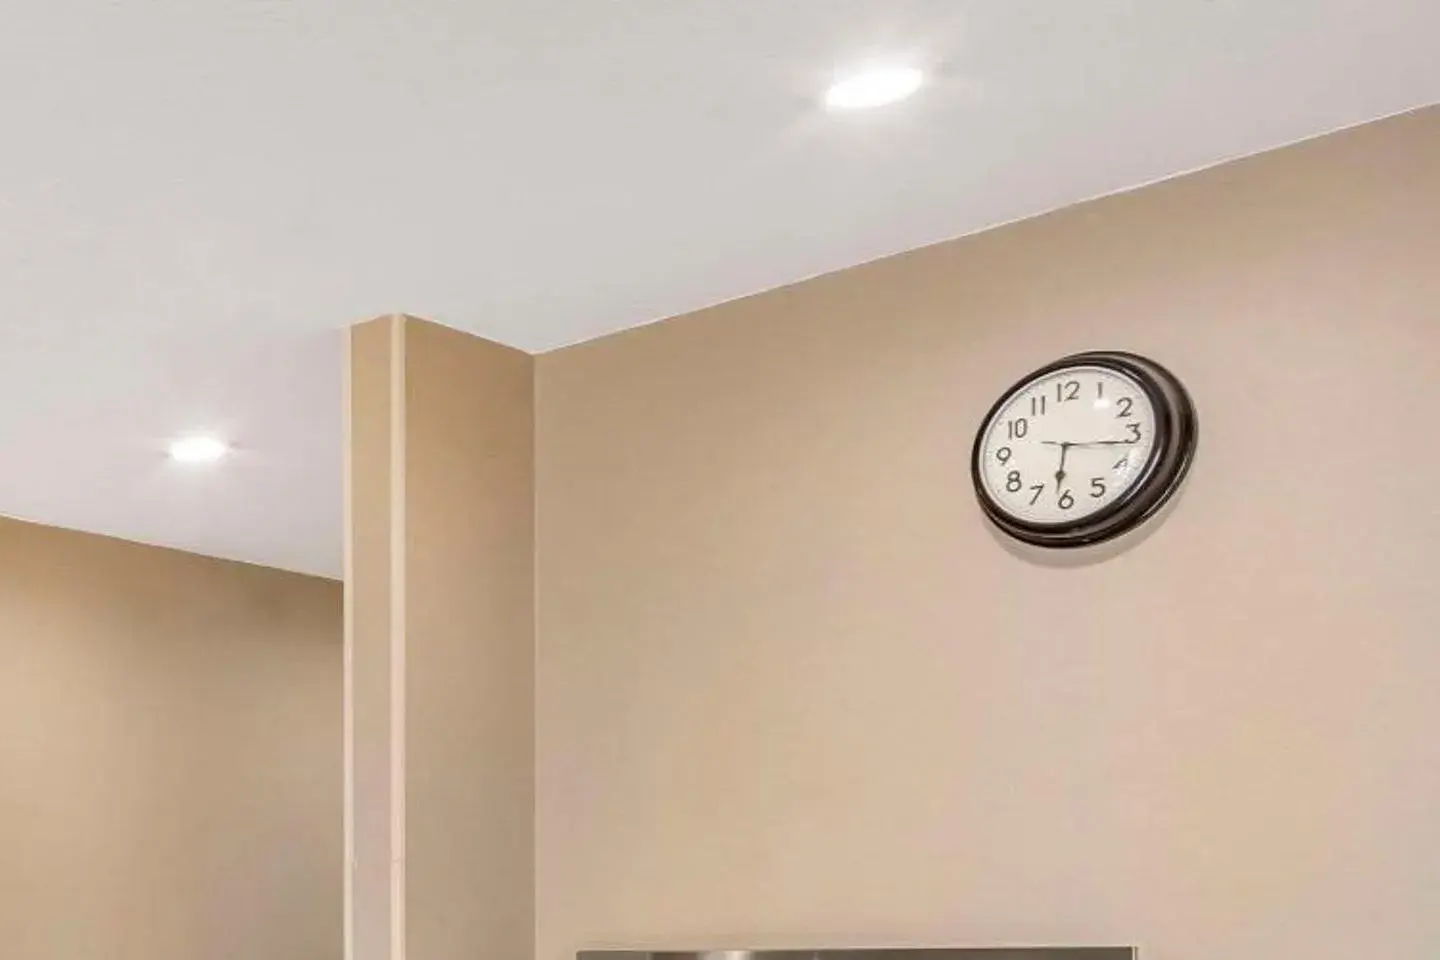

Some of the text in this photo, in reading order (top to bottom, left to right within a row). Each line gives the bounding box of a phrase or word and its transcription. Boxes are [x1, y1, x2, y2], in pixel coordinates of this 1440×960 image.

[1057, 381, 1080, 402] 12
[1097, 381, 1103, 399] 1
[1031, 395, 1046, 416] 11
[1116, 397, 1133, 418] 2
[1008, 418, 1028, 440] 10
[1125, 423, 1142, 443] 3
[996, 446, 1012, 465] 9
[1006, 471, 1022, 493] 8
[1090, 477, 1106, 498] 5
[1029, 483, 1045, 506] 7
[1058, 489, 1074, 510] 6
